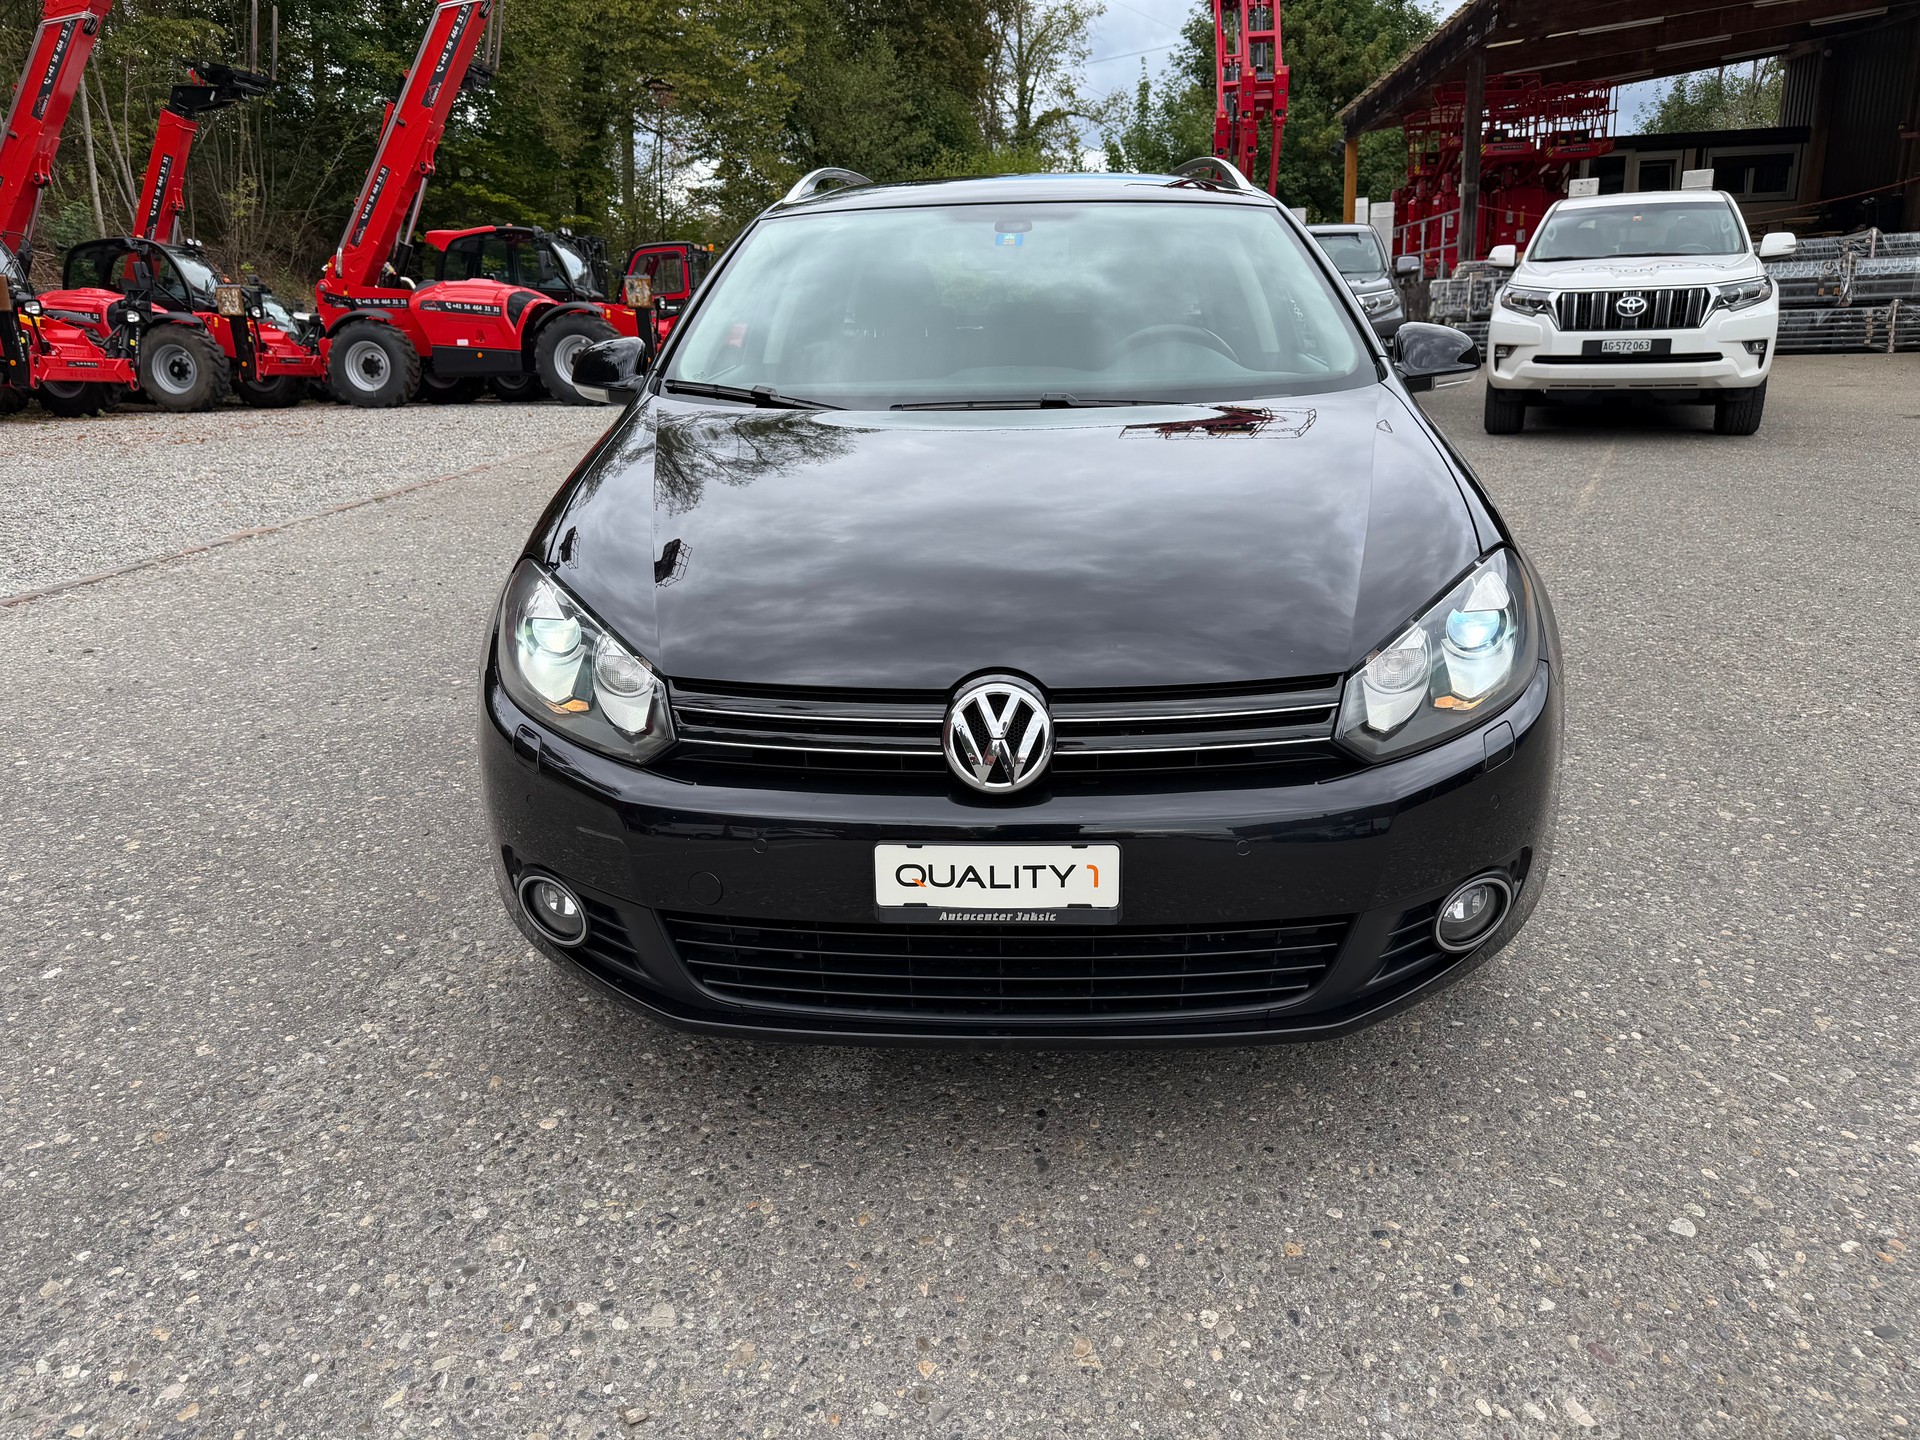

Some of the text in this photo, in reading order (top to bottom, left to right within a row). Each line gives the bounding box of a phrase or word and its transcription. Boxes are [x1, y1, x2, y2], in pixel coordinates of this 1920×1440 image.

[52, 54, 59, 63] 56
[56, 39, 64, 53] 464
[61, 29, 68, 38] 31
[440, 52, 449, 64] +41
[446, 41, 453, 50] 56
[451, 26, 460, 39] 464
[457, 15, 465, 24] 31
[895, 863, 1099, 889] QUALITY 1
[939, 911, 1057, 922] Autocenter Jaksic
